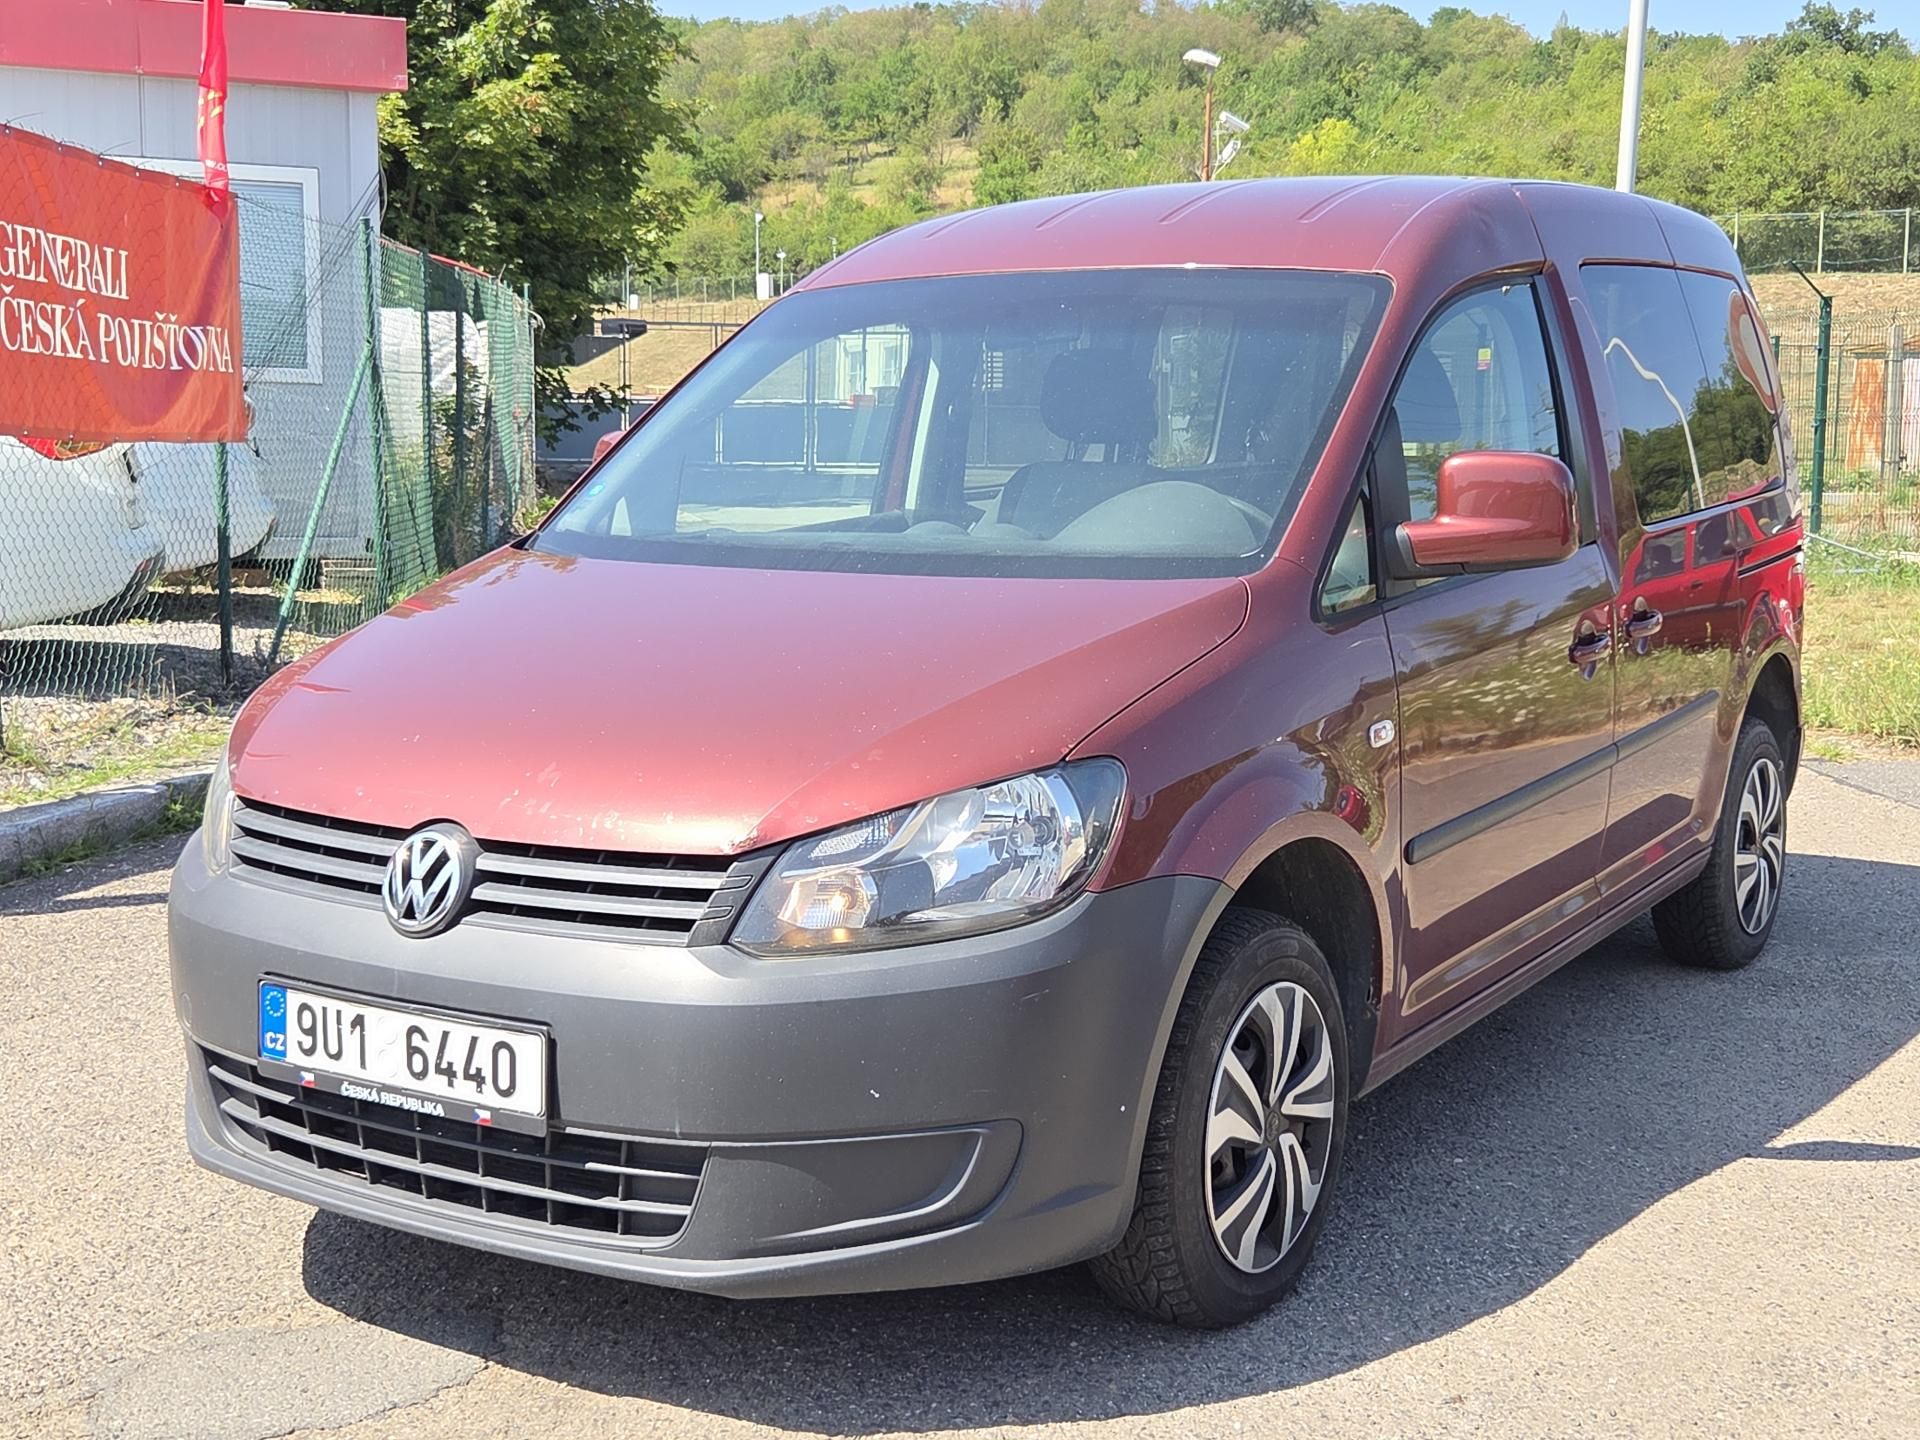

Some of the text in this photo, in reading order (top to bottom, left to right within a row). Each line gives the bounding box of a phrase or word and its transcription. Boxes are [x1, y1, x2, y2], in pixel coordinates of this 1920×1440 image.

[0, 221, 129, 300] GENERALI
[0, 283, 234, 373] ČESKÁ POJIŠŤOVNA
[264, 1031, 286, 1050] CZ
[297, 1002, 517, 1098] 9U1 6440
[341, 1081, 445, 1117] ČESKÁ REPUBLIKA
